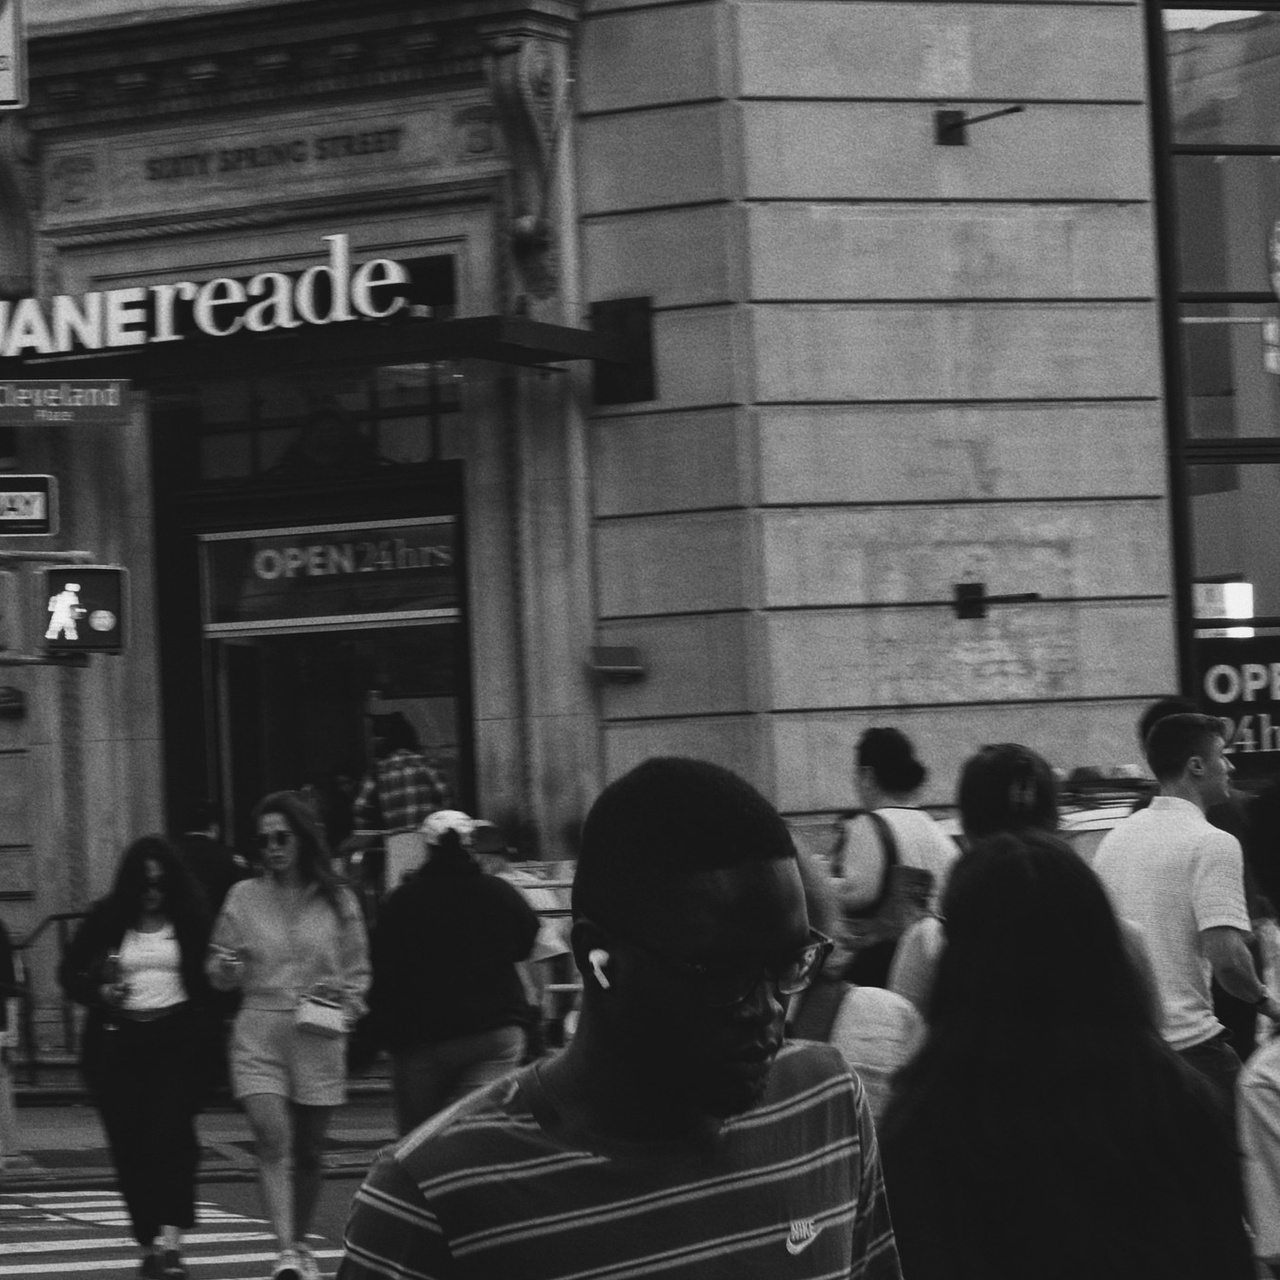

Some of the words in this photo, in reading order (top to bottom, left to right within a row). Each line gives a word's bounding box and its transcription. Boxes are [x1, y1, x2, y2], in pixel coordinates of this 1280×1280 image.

[218, 140, 308, 174] SPRING
[313, 127, 403, 161] STREET
[253, 544, 355, 580] OPEN
[791, 1218, 816, 1241] NIKE
